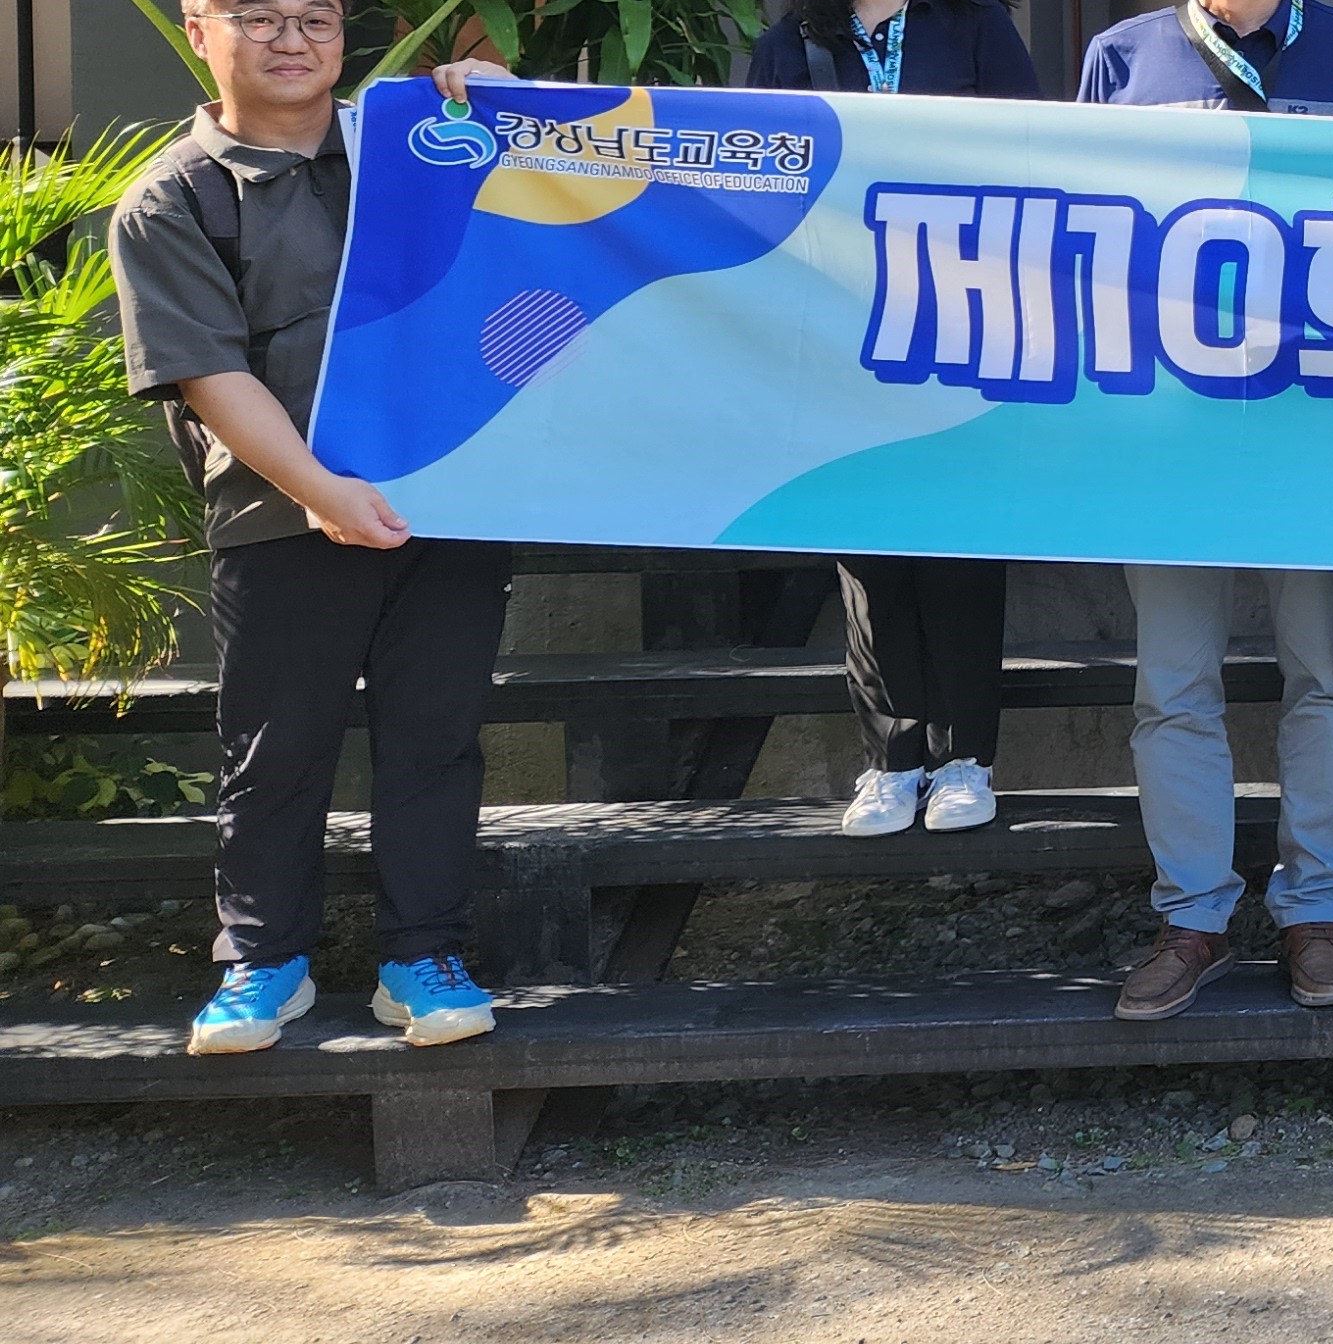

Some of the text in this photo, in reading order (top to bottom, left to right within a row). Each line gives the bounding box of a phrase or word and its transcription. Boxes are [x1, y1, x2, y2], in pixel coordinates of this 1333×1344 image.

[1287, 104, 1309, 114] K2
[496, 113, 813, 173] 경상남도교육청
[500, 154, 808, 193] GYEONGSANGNAMDO OFFICE OF EDUCATION
